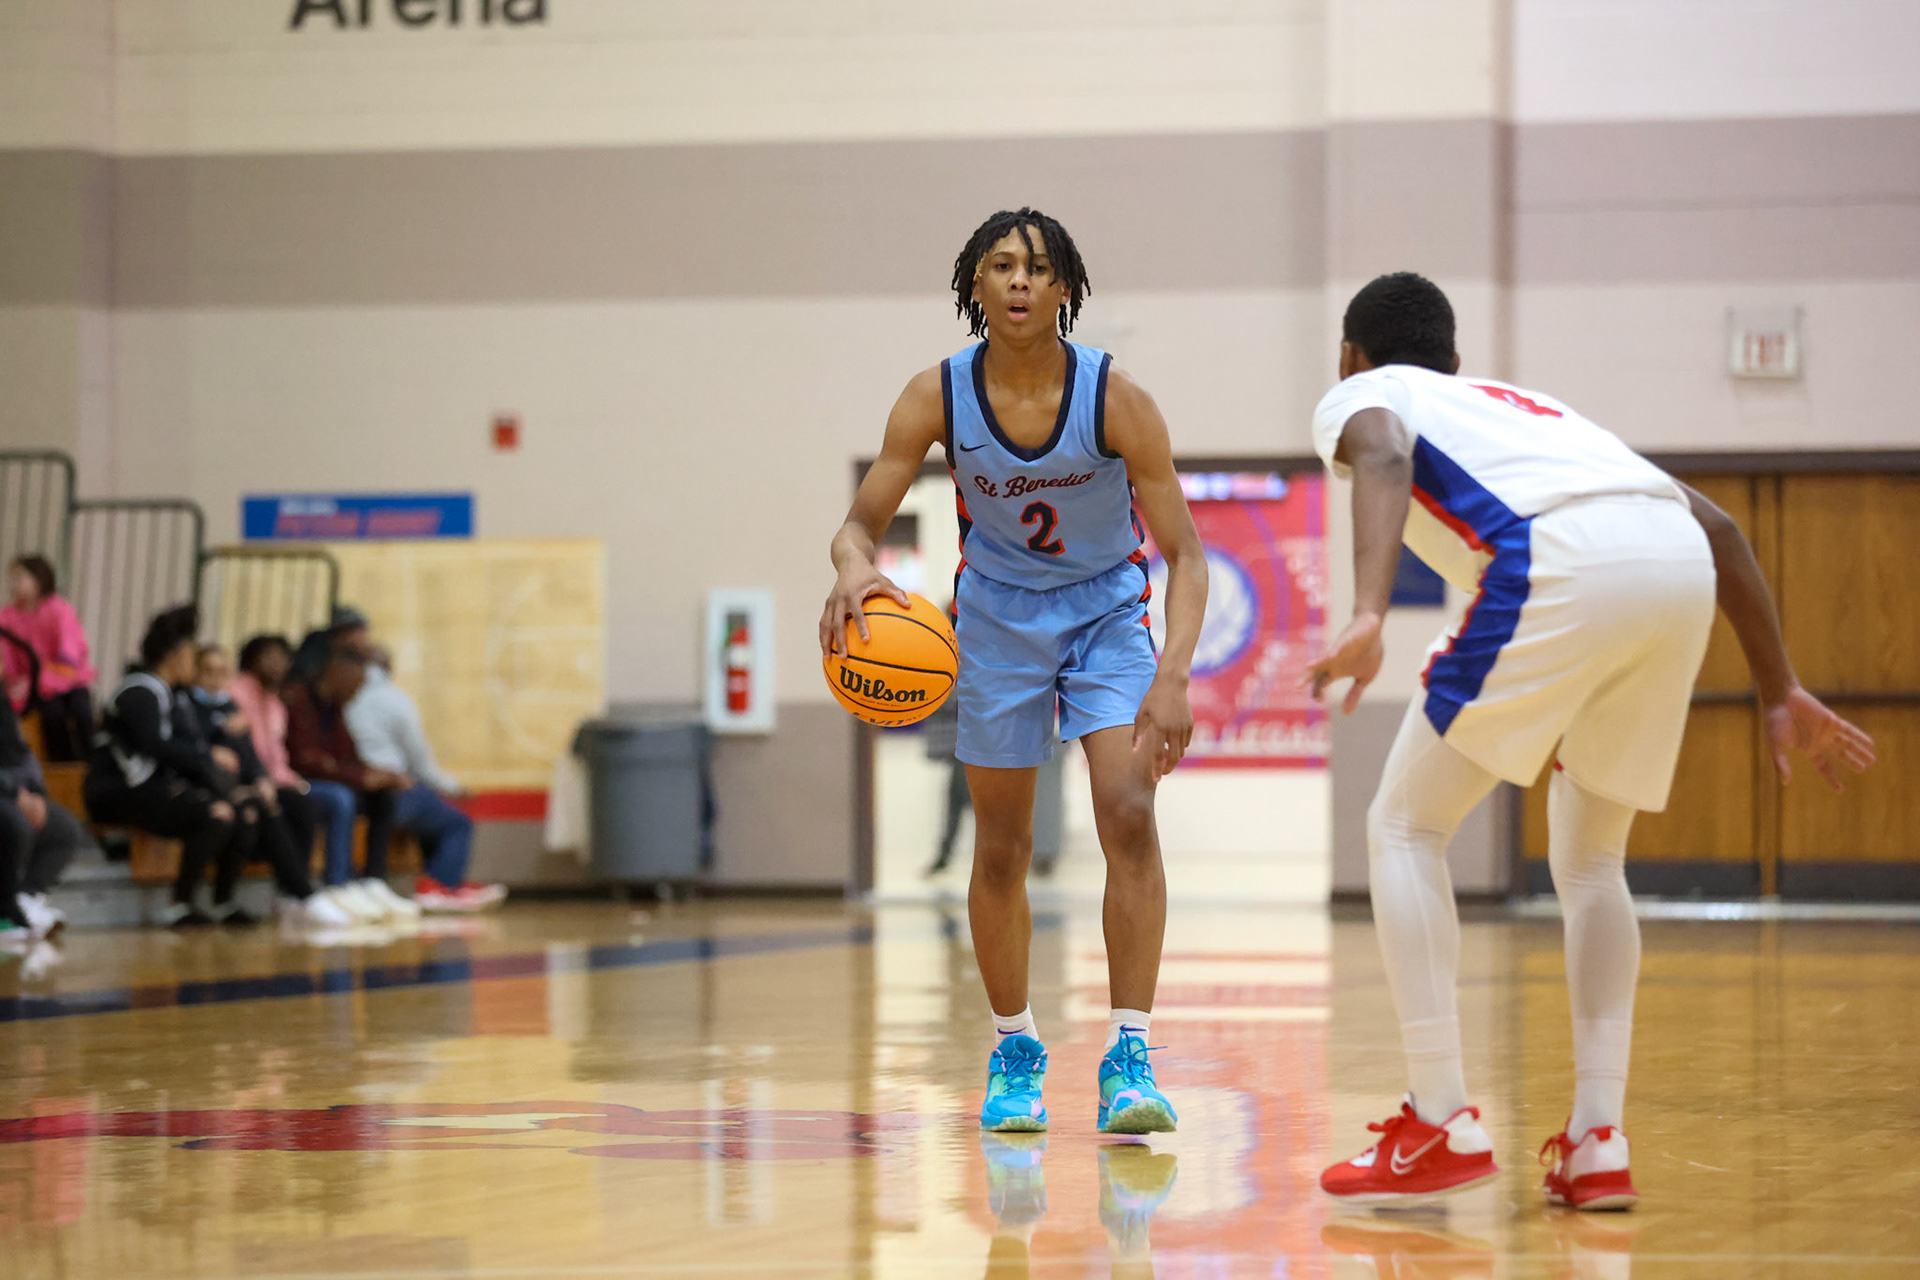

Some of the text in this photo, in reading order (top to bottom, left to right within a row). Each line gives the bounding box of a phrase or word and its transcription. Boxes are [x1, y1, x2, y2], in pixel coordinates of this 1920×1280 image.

[974, 475, 998, 497] St
[1020, 501, 1065, 555] 2
[840, 665, 926, 702] Wilson
